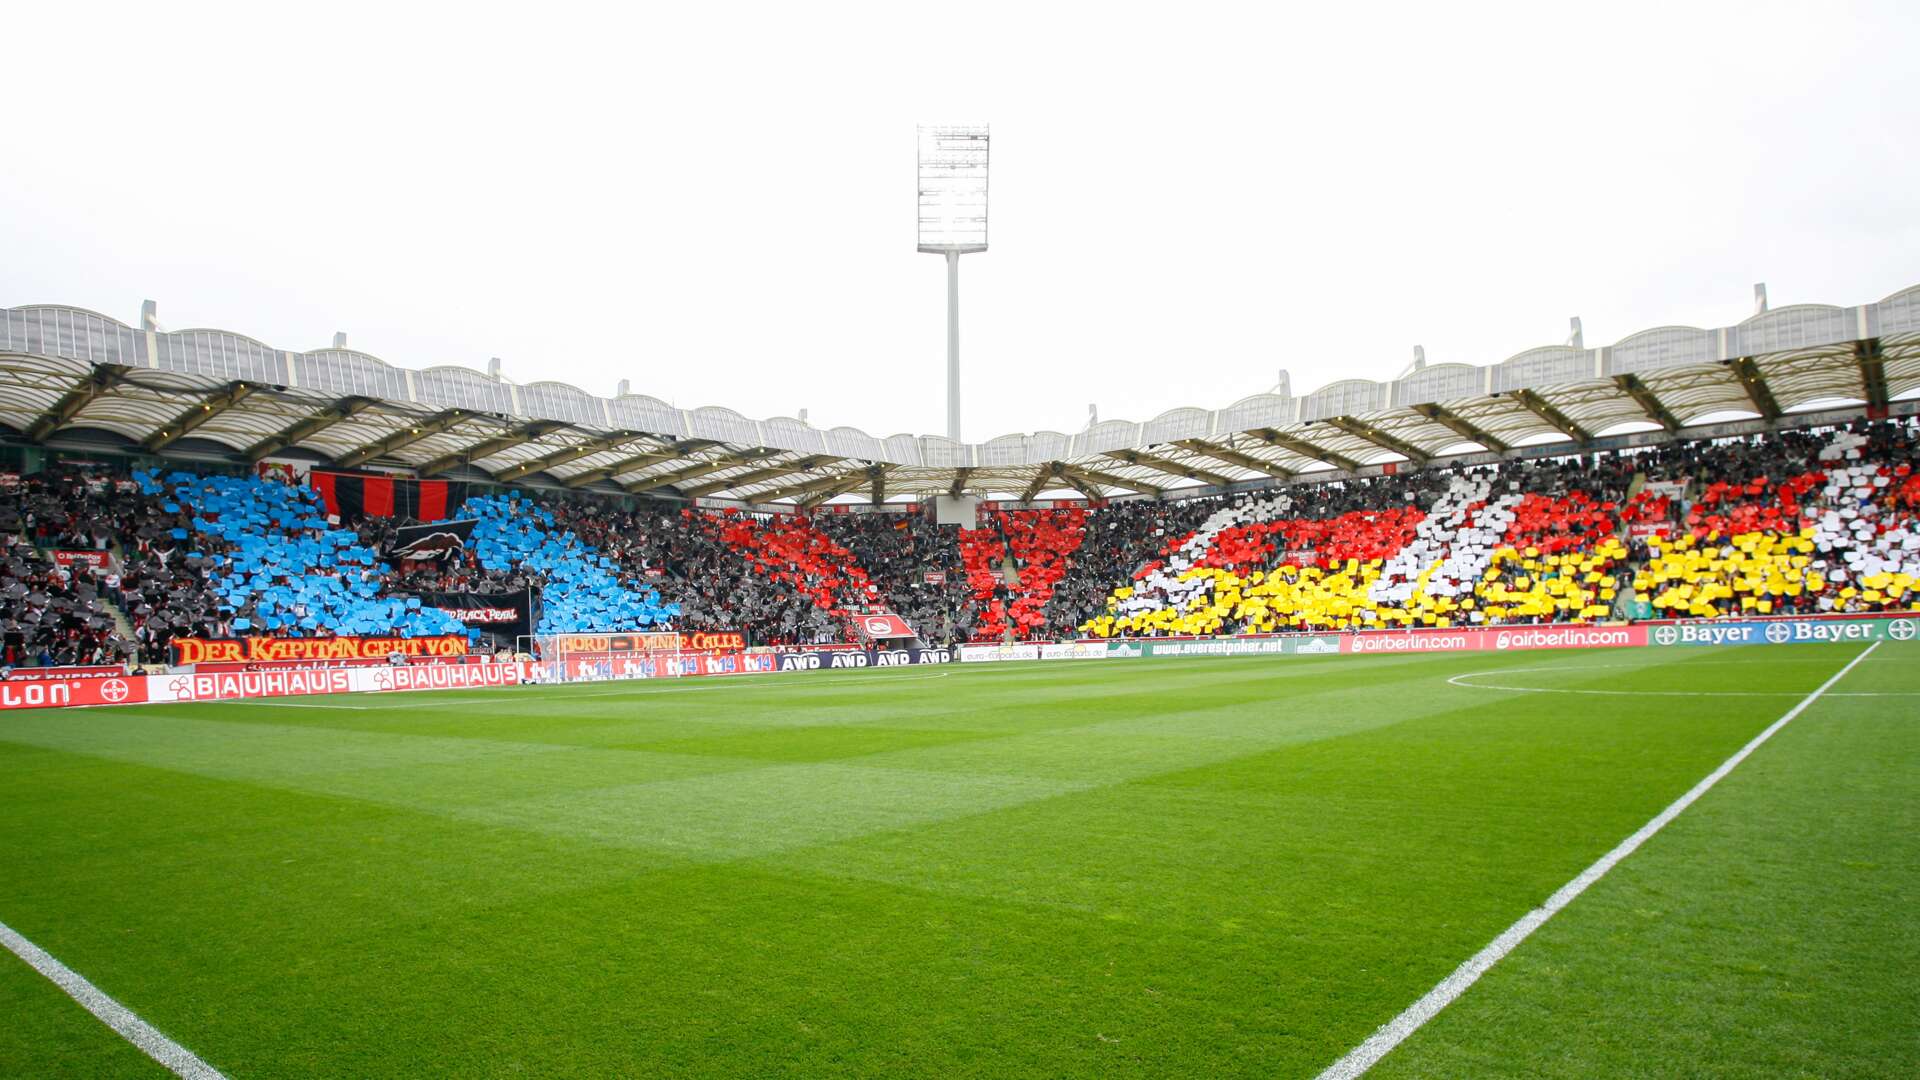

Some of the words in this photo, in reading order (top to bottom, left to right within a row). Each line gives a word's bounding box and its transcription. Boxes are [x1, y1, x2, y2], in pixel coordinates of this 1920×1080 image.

[1514, 629, 1630, 647] airberlin.com
[1681, 625, 1753, 644] Bayer
[1793, 622, 1874, 642] Bayer
[692, 632, 745, 650] CALLE
[1152, 639, 1283, 655] www.everestpoker.net
[1364, 635, 1466, 650] airberlin.com
[174, 638, 249, 664] DER
[362, 638, 422, 657] GEHT
[424, 636, 467, 656] VON
[919, 651, 950, 664] AWD
[705, 656, 736, 673] tv14
[743, 655, 771, 672] tv14
[782, 656, 821, 671] AWD
[831, 655, 868, 668] AWD
[877, 653, 910, 665] AWD
[197, 671, 348, 695] BAUHAUS
[396, 665, 517, 686] BAUHAUS
